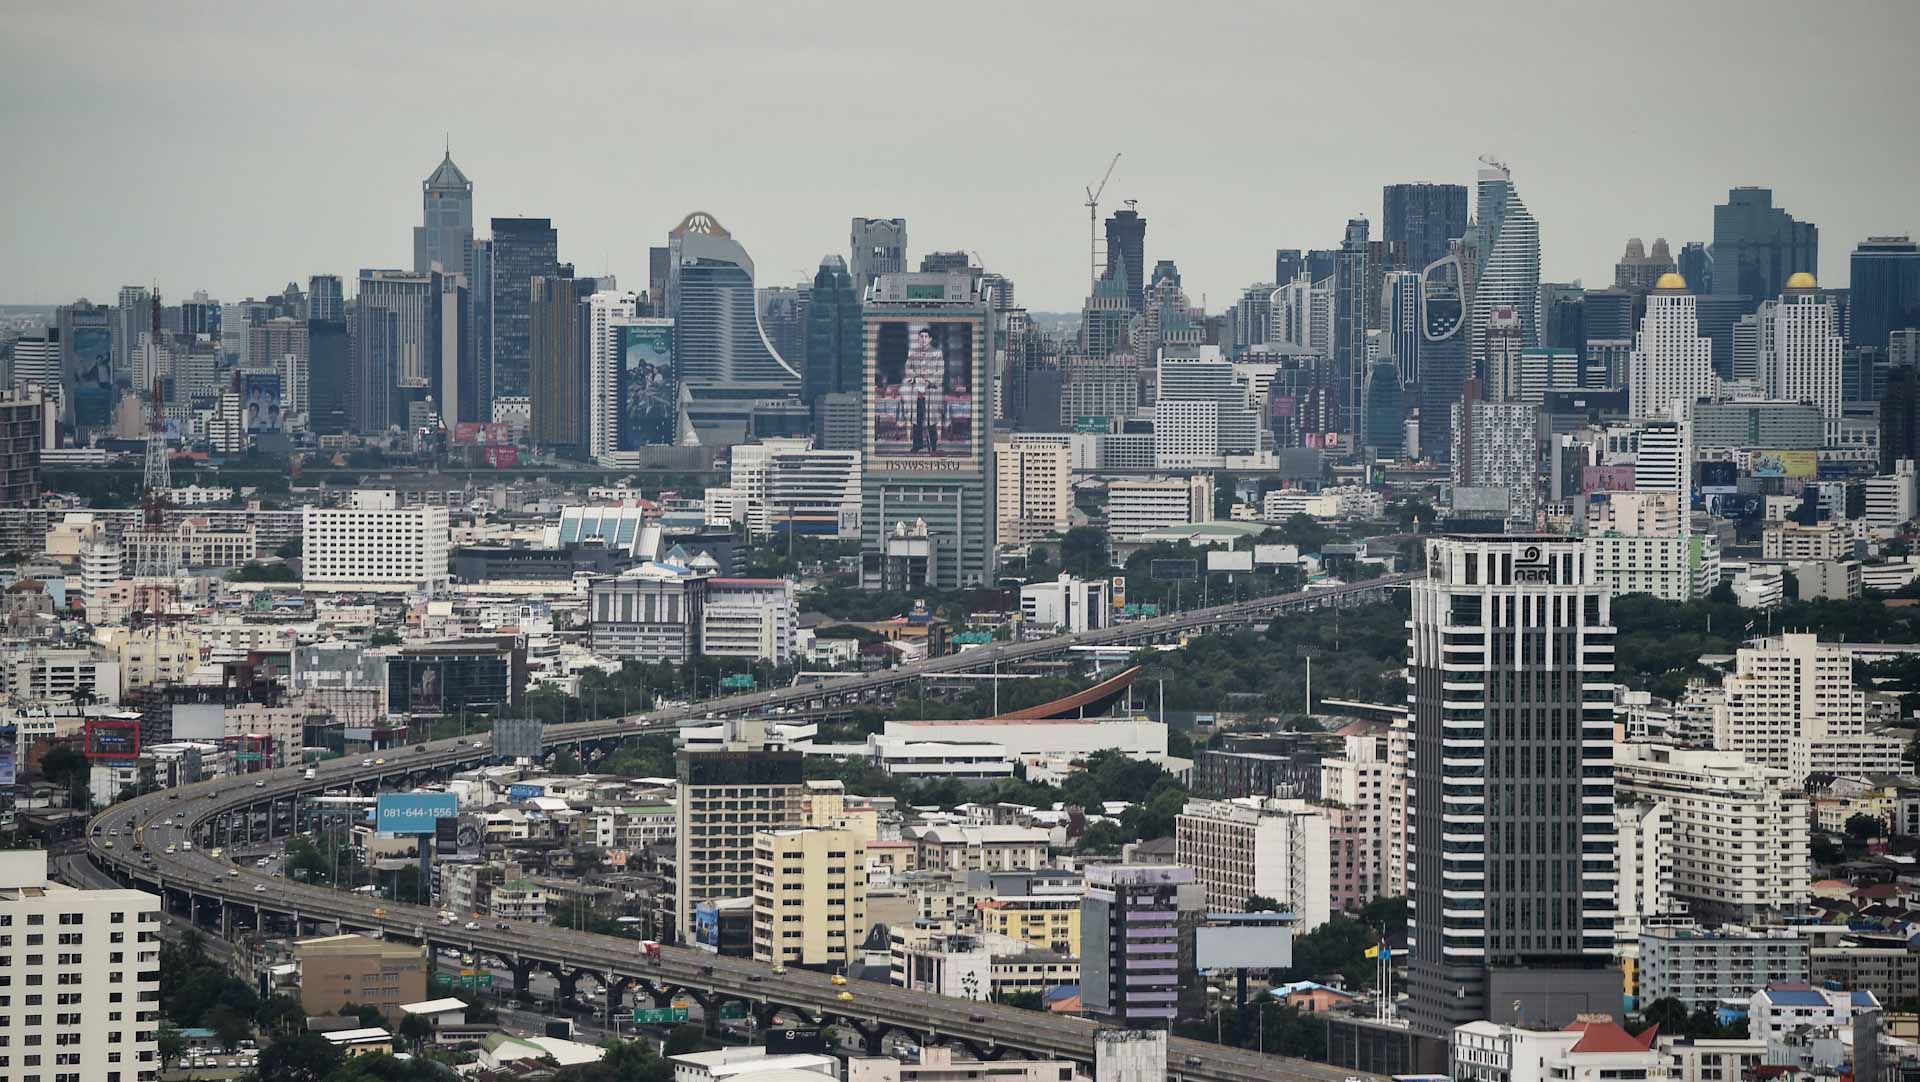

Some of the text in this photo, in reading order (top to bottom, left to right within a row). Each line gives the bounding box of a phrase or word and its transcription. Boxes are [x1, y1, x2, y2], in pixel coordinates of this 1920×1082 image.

[886, 459, 960, 472] ทรงพระเจริญ
[383, 807, 452, 818] 081-644-1556
